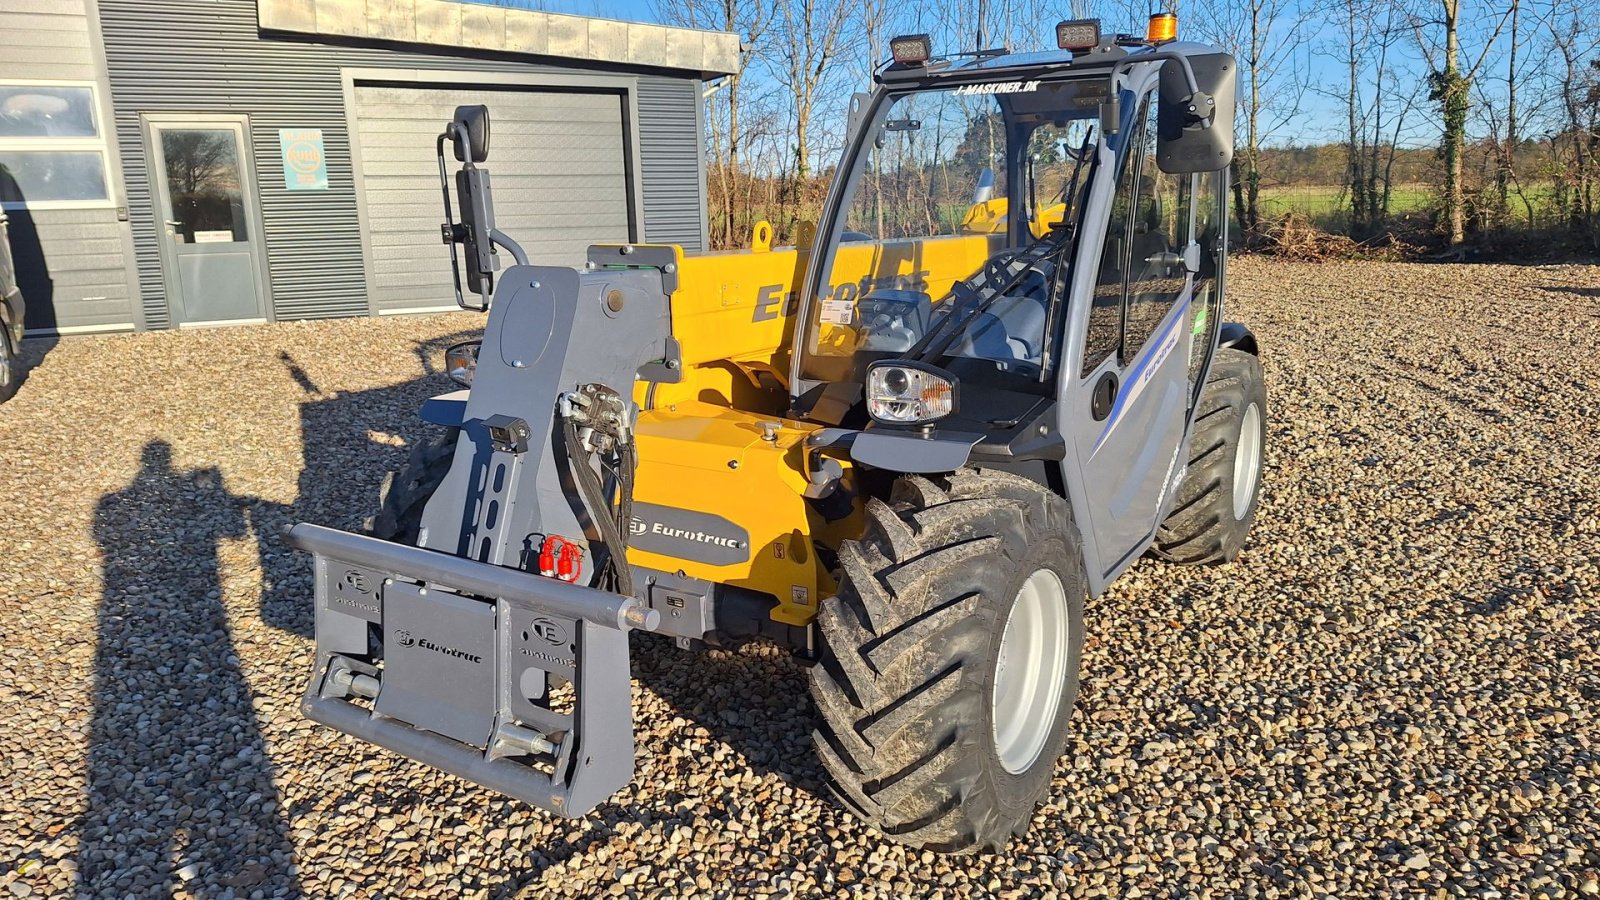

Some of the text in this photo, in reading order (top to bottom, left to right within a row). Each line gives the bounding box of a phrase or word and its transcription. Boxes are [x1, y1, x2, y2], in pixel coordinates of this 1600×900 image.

[953, 80, 1040, 96] J-MASKINER.DK
[652, 522, 738, 549] Eurotrac
[418, 638, 483, 664] Eurotrac
